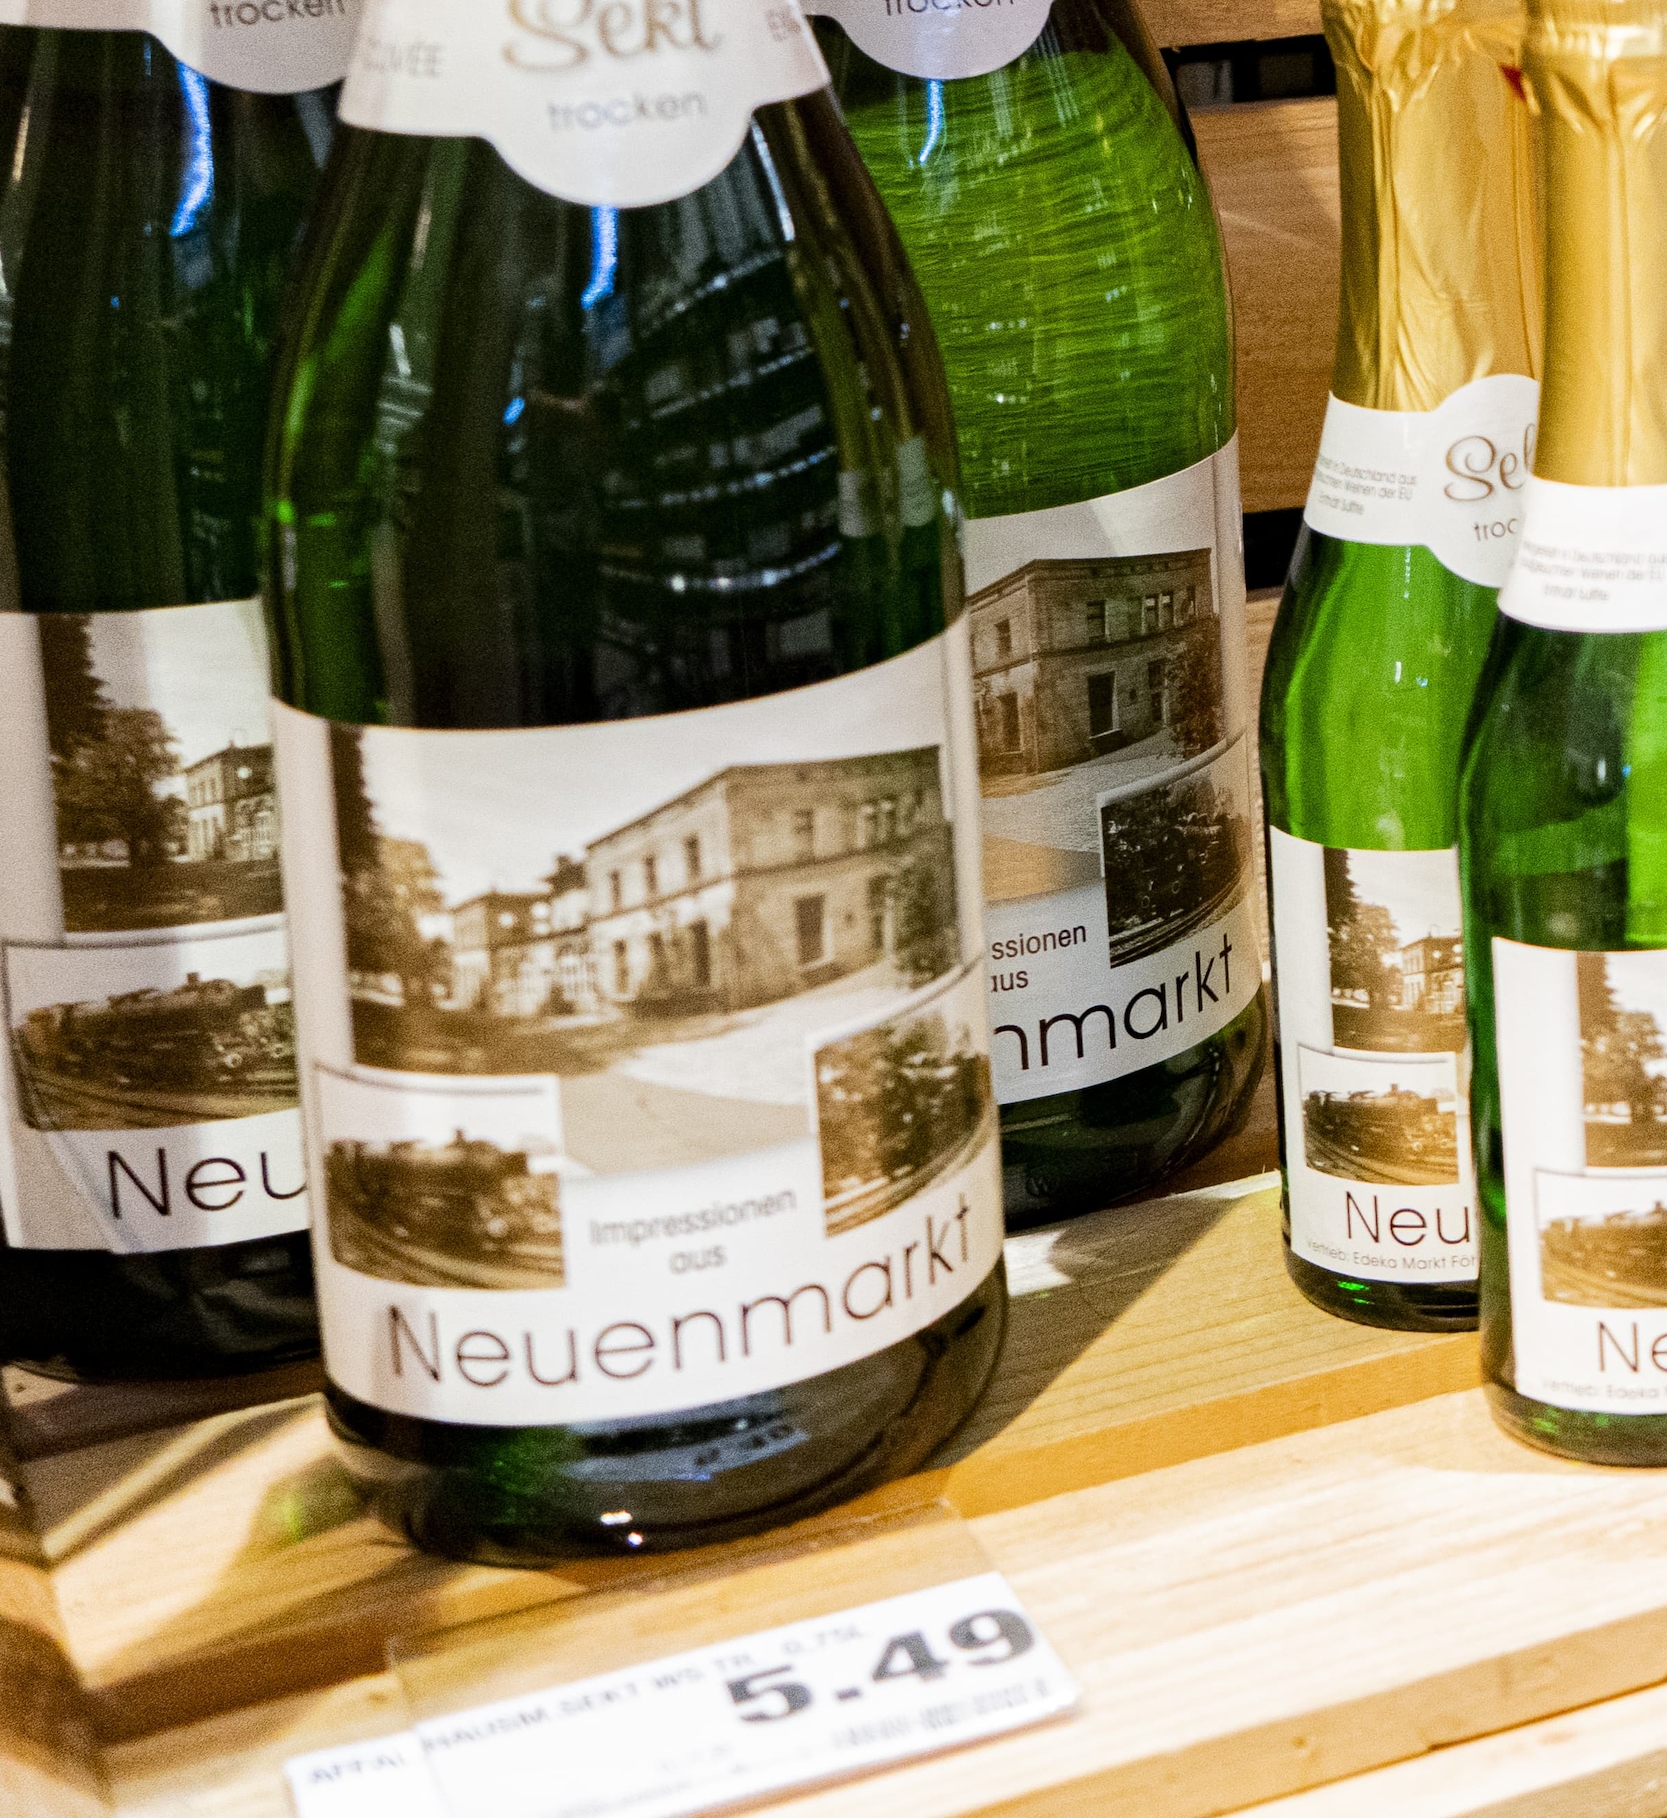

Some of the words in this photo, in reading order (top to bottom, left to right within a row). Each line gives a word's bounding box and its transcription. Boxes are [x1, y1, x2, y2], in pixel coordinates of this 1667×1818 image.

[547, 89, 708, 133] trocken
[588, 1185, 797, 1246] Impressionen
[1346, 1190, 1470, 1246] Neu
[670, 1242, 727, 1276] aus
[1353, 1252, 1398, 1269] Edeka
[1402, 1257, 1447, 1270] Markt
[387, 1191, 971, 1387] Neuenmarkt
[725, 1608, 1036, 1724] 5.49
